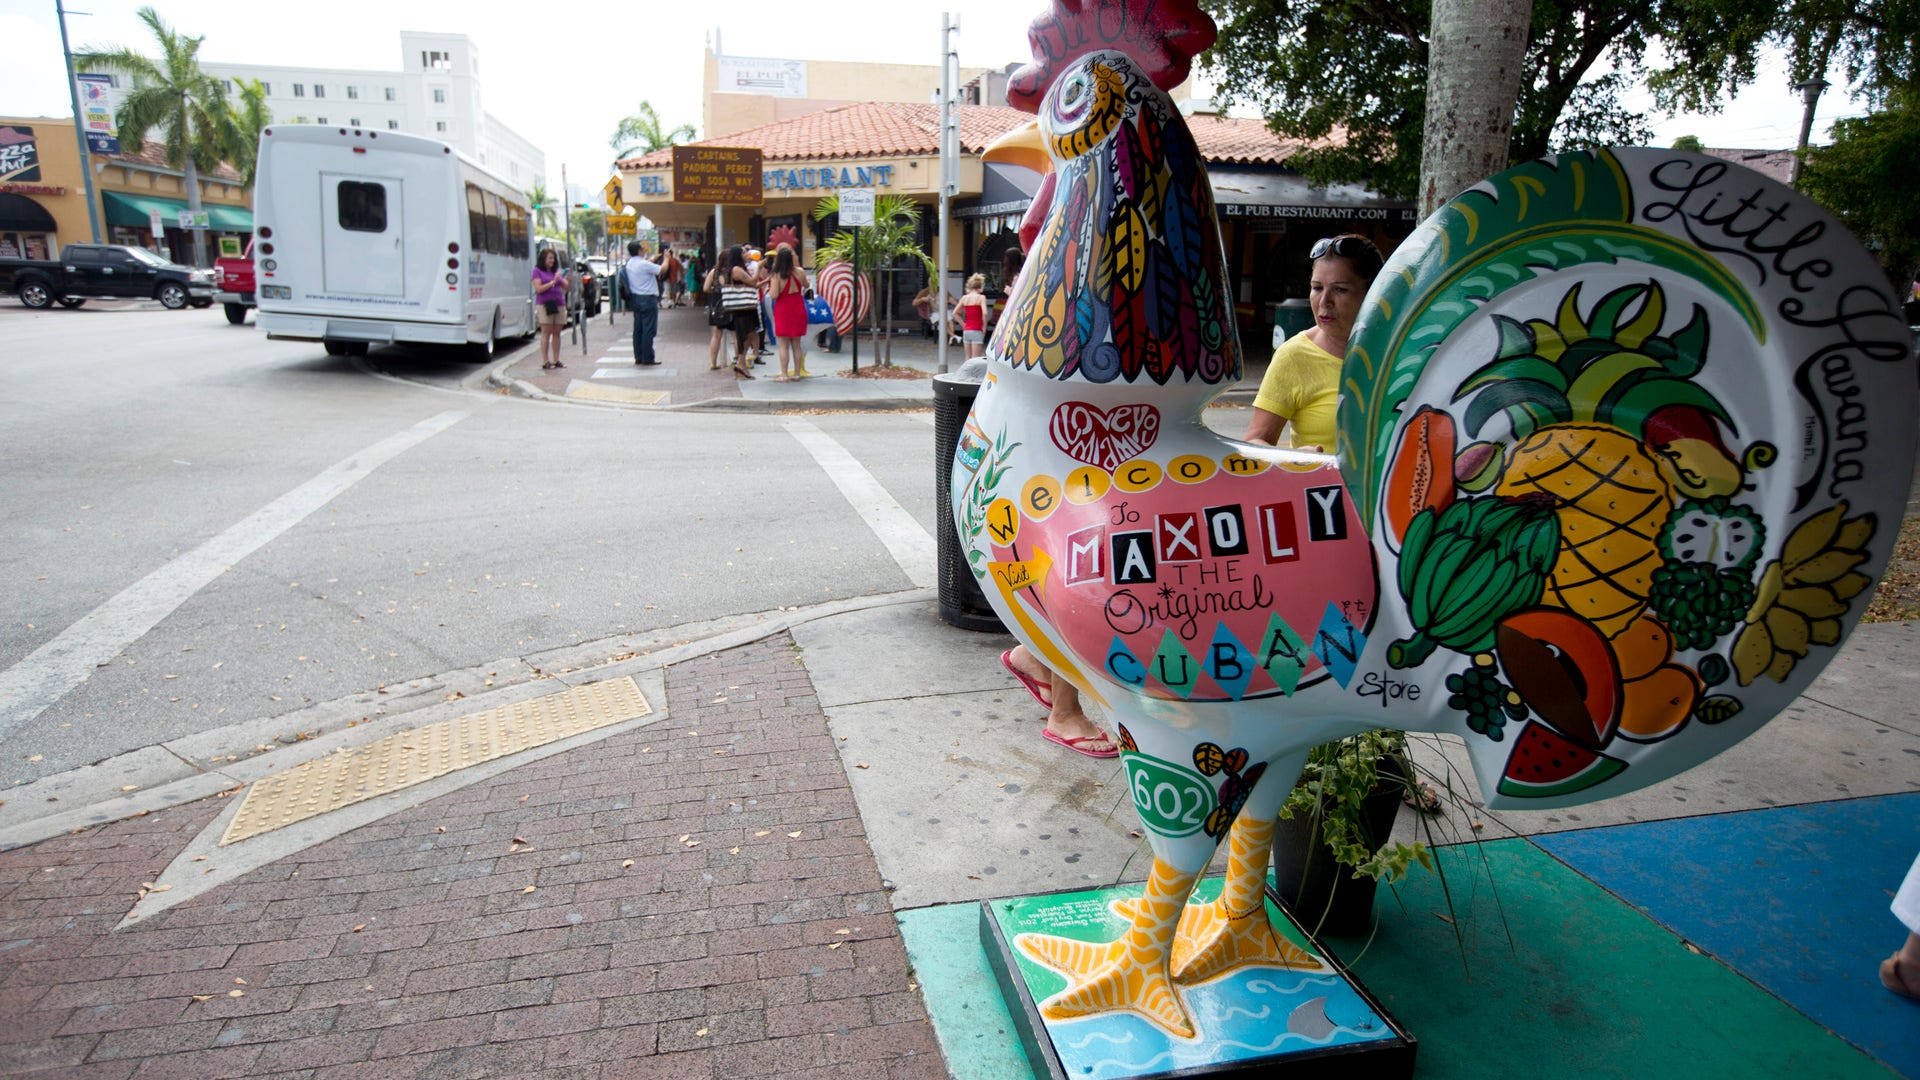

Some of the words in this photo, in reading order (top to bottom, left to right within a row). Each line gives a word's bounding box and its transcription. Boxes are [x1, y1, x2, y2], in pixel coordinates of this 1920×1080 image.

[0, 144, 36, 159] zza
[697, 151, 738, 161] CAPTAINS
[640, 175, 667, 194] EL
[762, 165, 893, 190] STAURANT
[683, 176, 701, 185] AND
[707, 176, 729, 186] SOSA
[735, 177, 753, 186] WAY
[725, 164, 753, 174] PEREZ
[607, 220, 635, 230] HEAD
[1226, 205, 1242, 216] EL
[1246, 205, 1271, 217] PUB
[1401, 210, 1416, 220] EL
[1642, 159, 1834, 292] Little
[1778, 284, 1909, 514] Havana
[990, 456, 1314, 541] Welcom
[1110, 501, 1140, 525] To
[1069, 487, 1342, 581] MAXOLY
[998, 563, 1030, 587] Visit
[1172, 560, 1245, 585] THE
[1104, 574, 1274, 640] Original
[1109, 624, 1359, 685] CUBAN
[1356, 670, 1421, 708] Store
